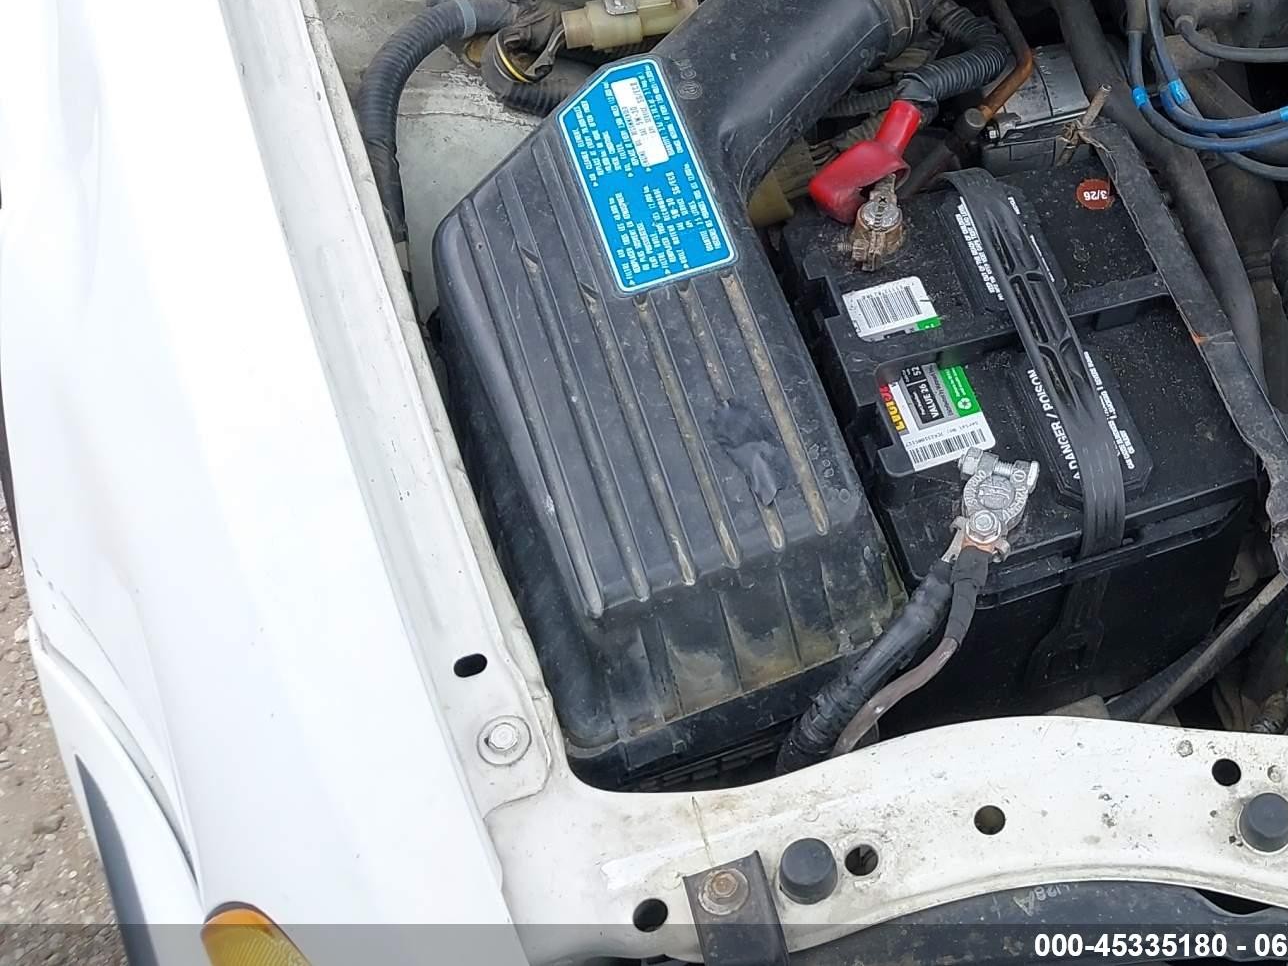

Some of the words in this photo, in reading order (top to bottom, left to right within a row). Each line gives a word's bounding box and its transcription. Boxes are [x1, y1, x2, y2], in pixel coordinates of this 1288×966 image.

[1083, 189, 1107, 200] 3/26
[666, 198, 680, 219] 5W-30
[910, 364, 922, 376] 52
[918, 382, 928, 393] 26
[1027, 367, 1054, 412] POISON
[922, 392, 939, 418] VALUE
[1051, 421, 1078, 471] DANGER
